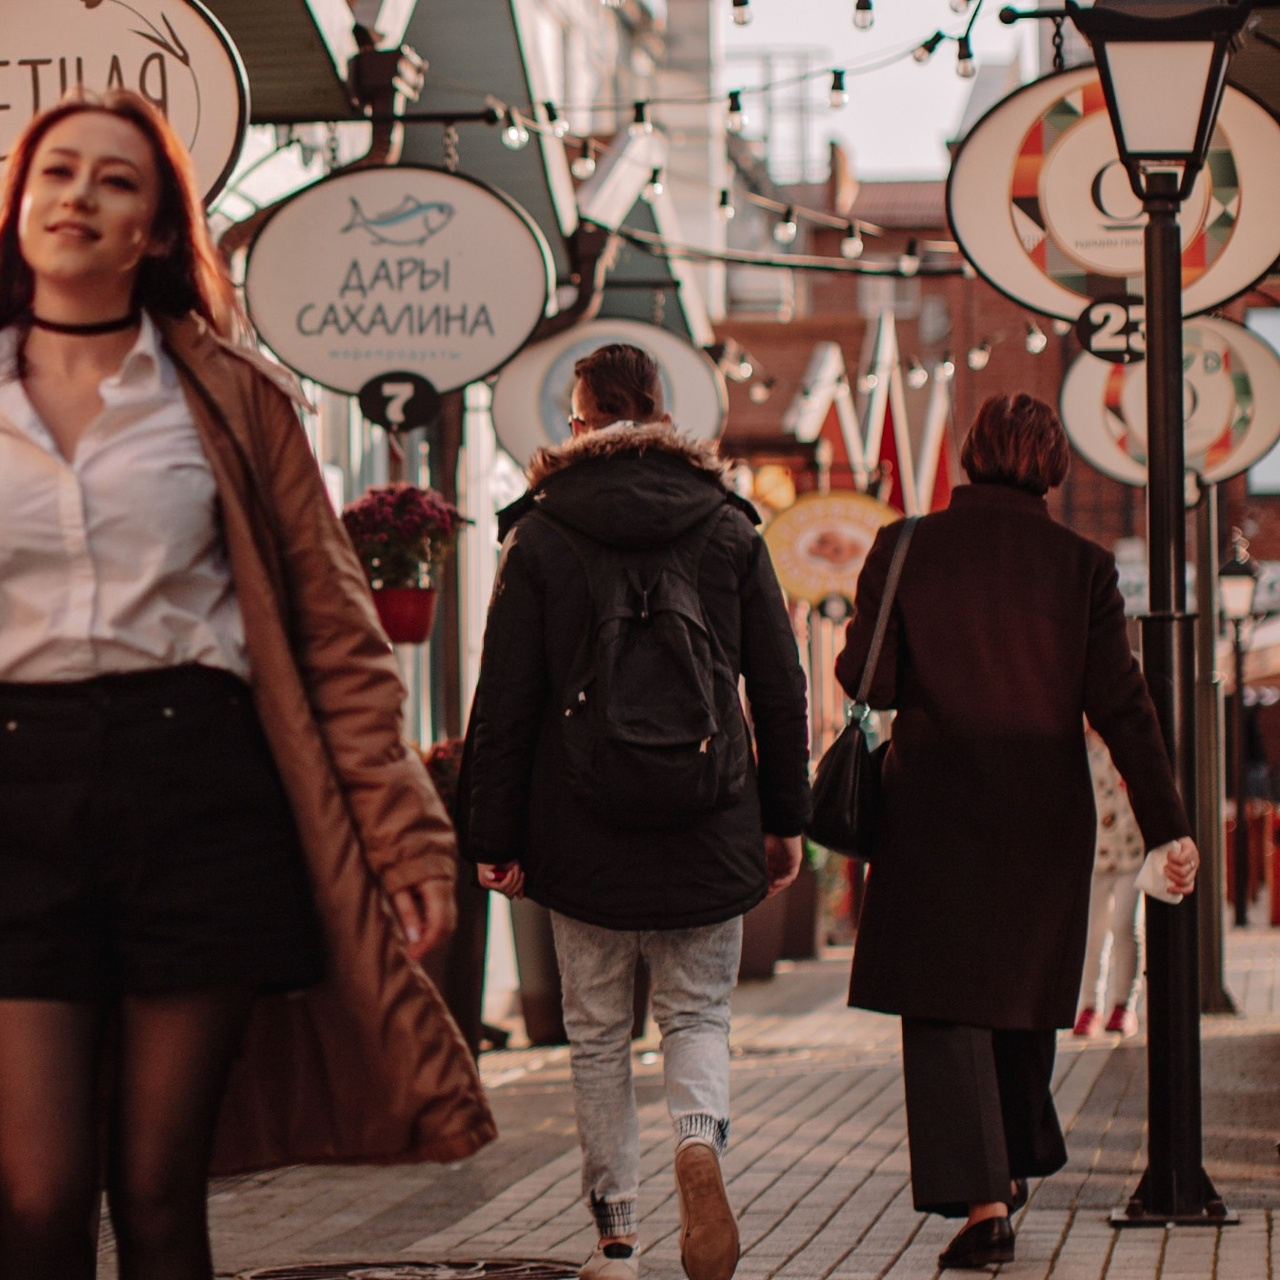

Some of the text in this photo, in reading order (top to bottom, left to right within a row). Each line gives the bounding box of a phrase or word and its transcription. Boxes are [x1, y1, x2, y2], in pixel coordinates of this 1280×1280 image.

[338, 257, 451, 299] ДАРЫ
[295, 302, 496, 338] САХАЛИНА
[381, 381, 415, 424] 7
